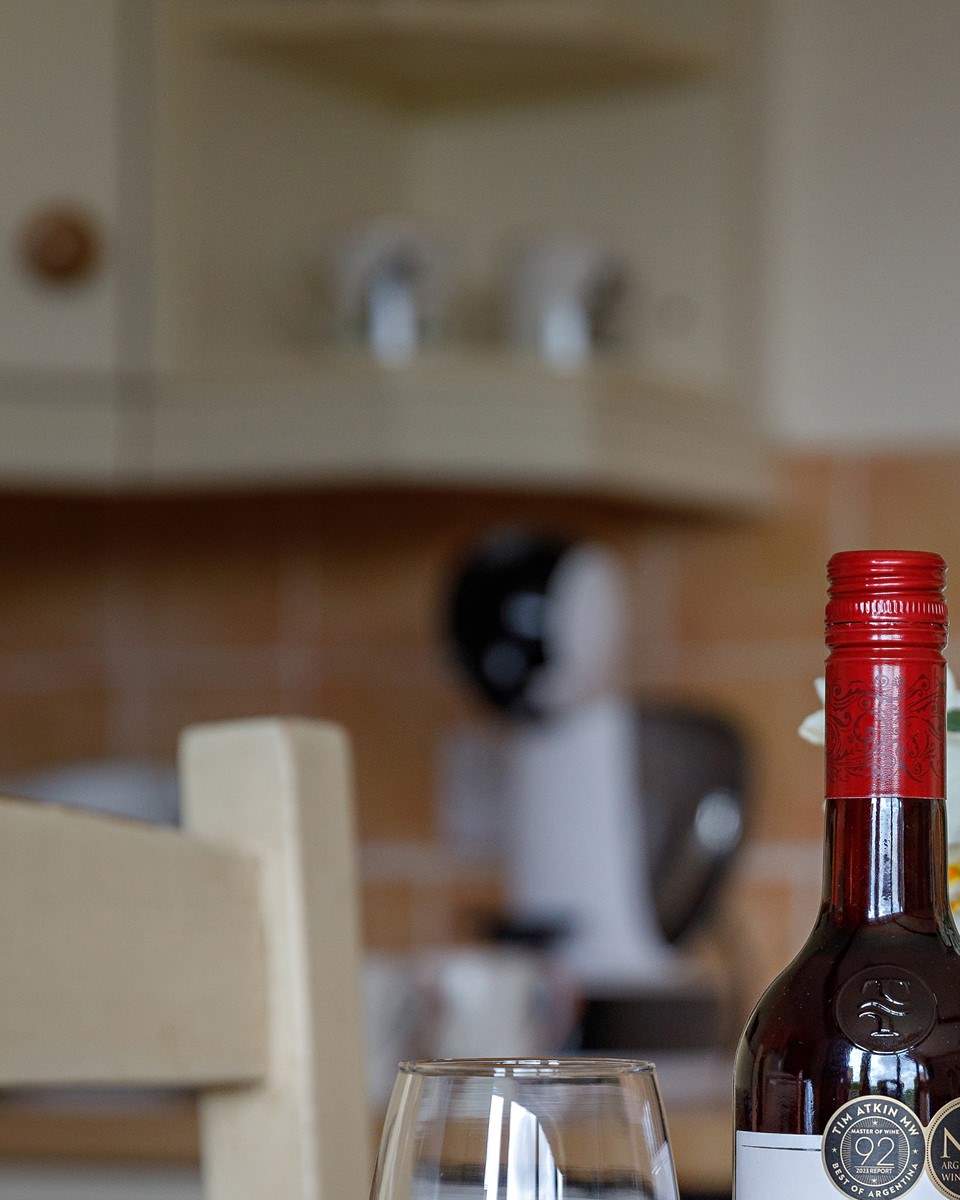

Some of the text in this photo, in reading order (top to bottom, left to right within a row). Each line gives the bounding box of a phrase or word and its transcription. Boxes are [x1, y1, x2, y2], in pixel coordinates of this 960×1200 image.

[832, 1103, 920, 1137] TIM ATKIN MW
[855, 1136, 895, 1166] 92
[832, 1162, 919, 1198] BEST OF ARGENTINA
